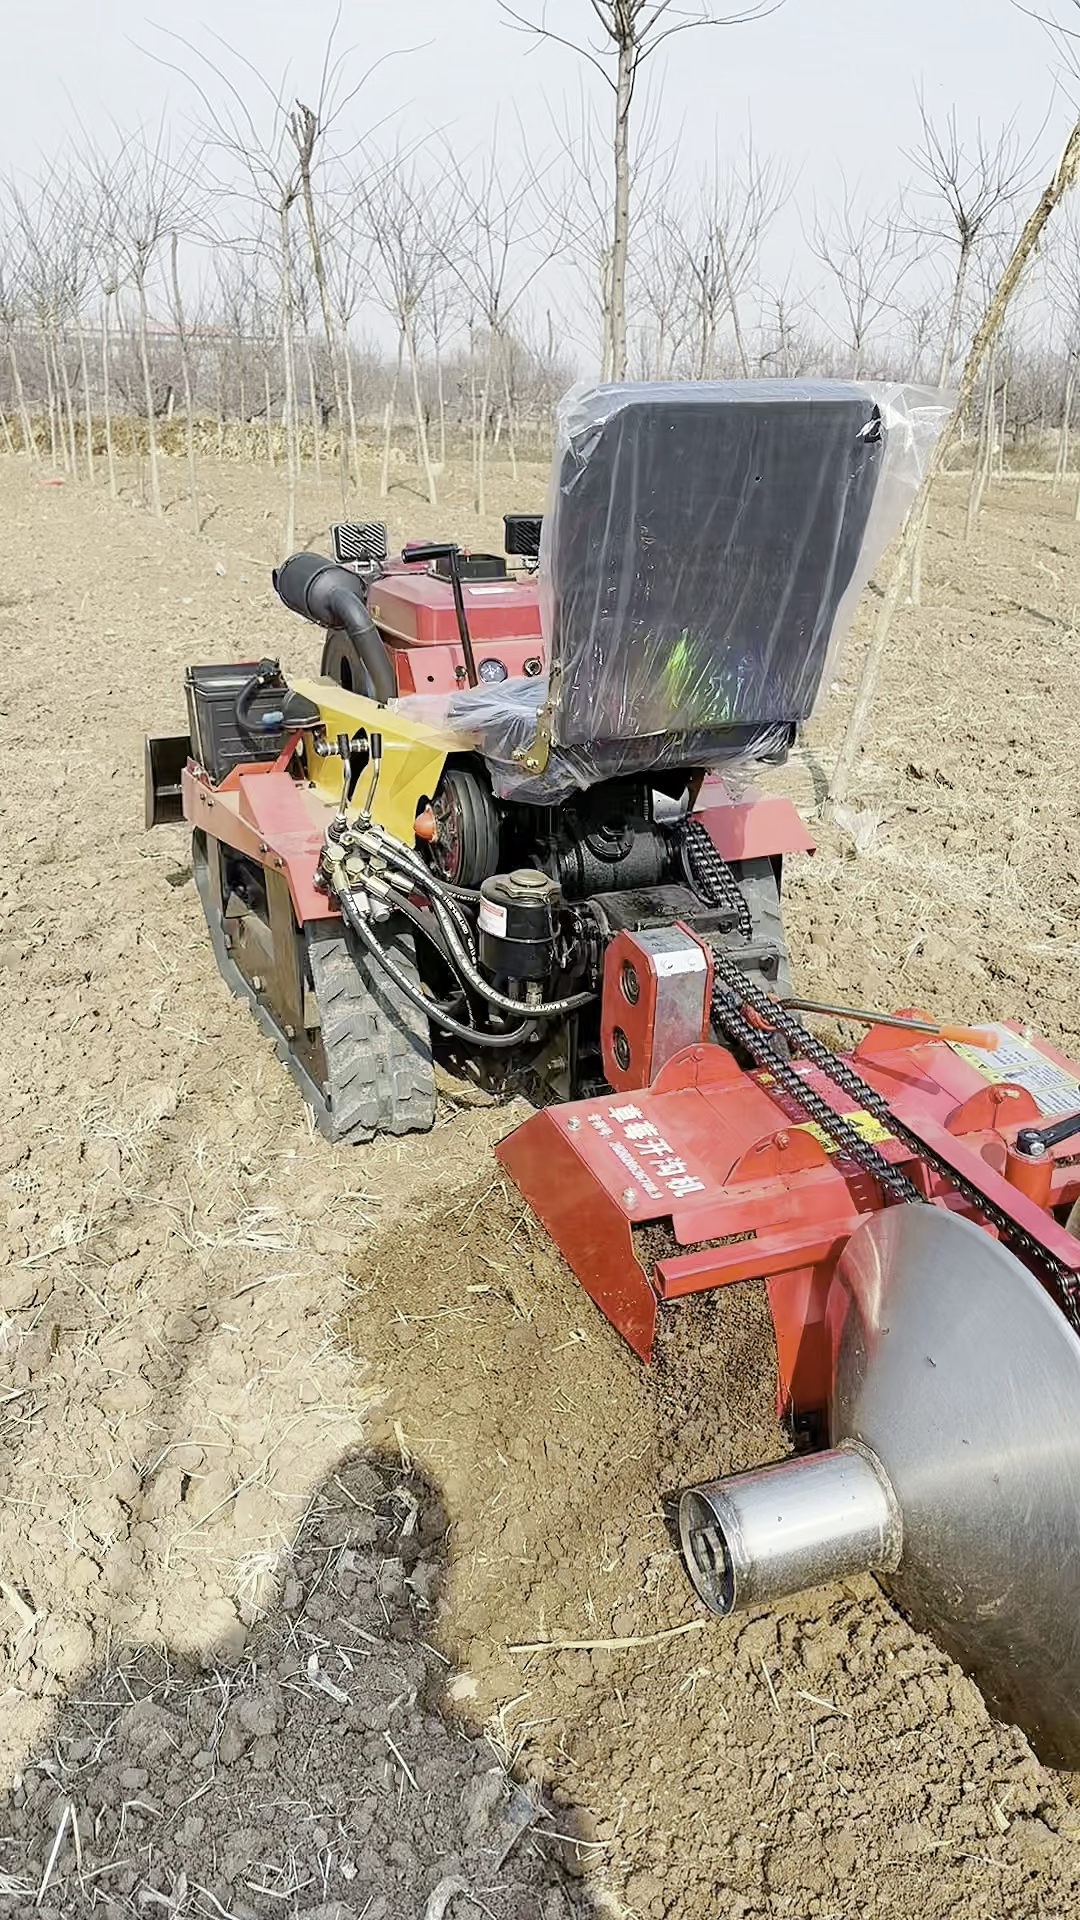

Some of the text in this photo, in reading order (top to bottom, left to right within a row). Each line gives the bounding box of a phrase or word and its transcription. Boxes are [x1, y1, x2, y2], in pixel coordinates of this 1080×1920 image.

[608, 1103, 706, 1198] 草莓开沟机
